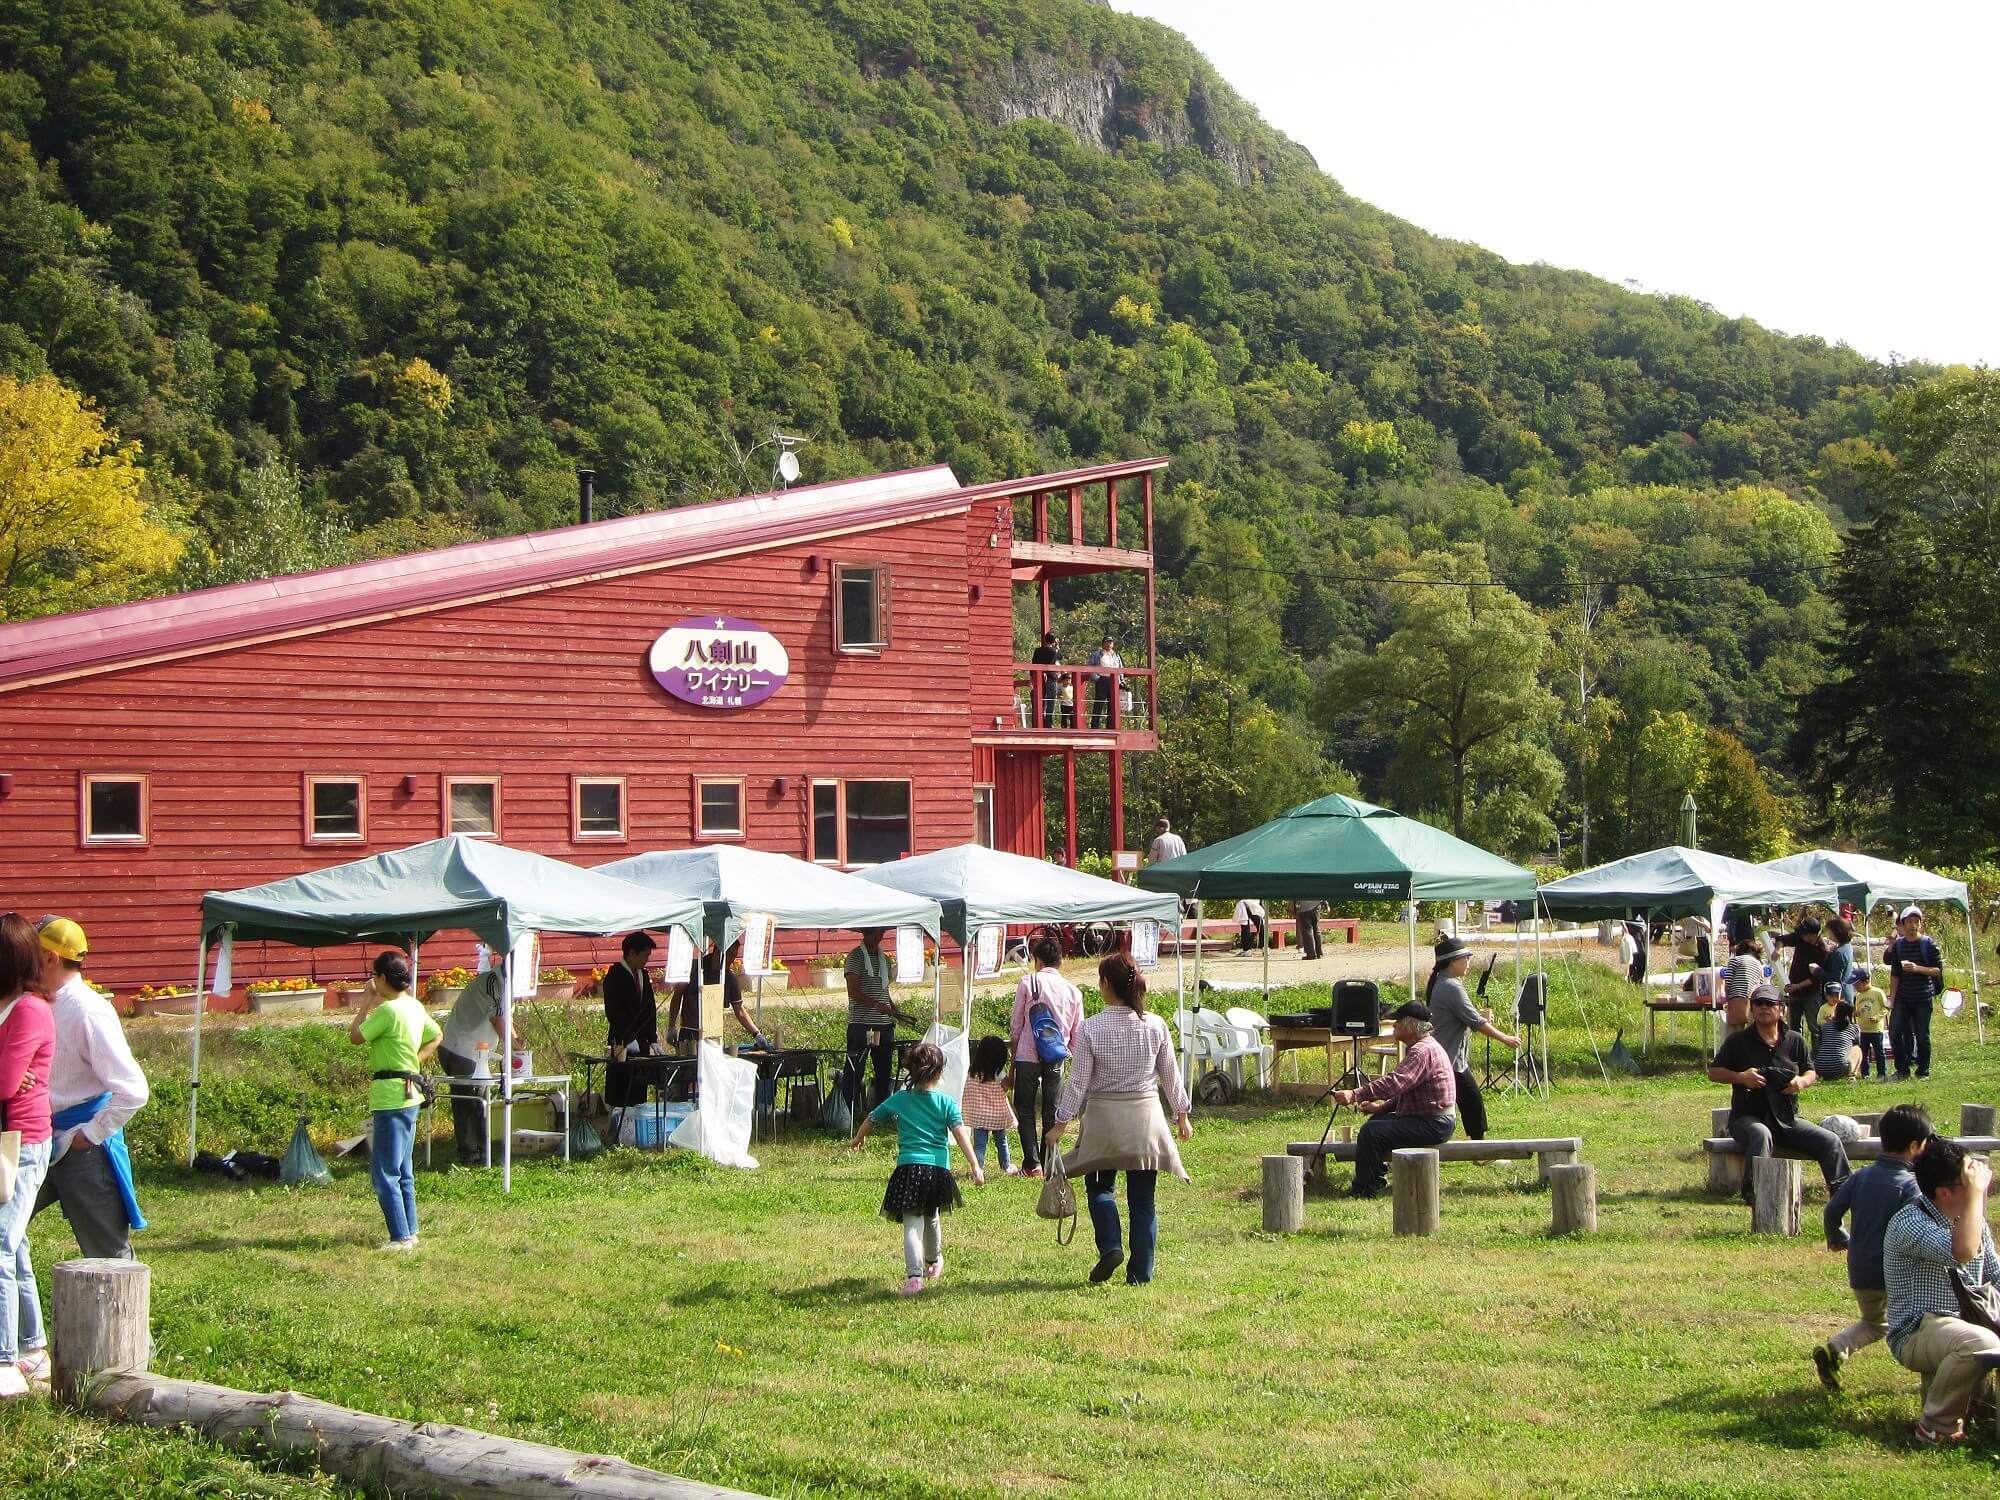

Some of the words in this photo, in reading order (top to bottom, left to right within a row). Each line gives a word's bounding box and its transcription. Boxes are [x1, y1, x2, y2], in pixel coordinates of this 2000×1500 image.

[684, 638, 758, 665] 八剣山
[687, 672, 770, 692] ワイナリー
[701, 695, 724, 705] 北海道
[1353, 882, 1382, 890] CAPTAIN
